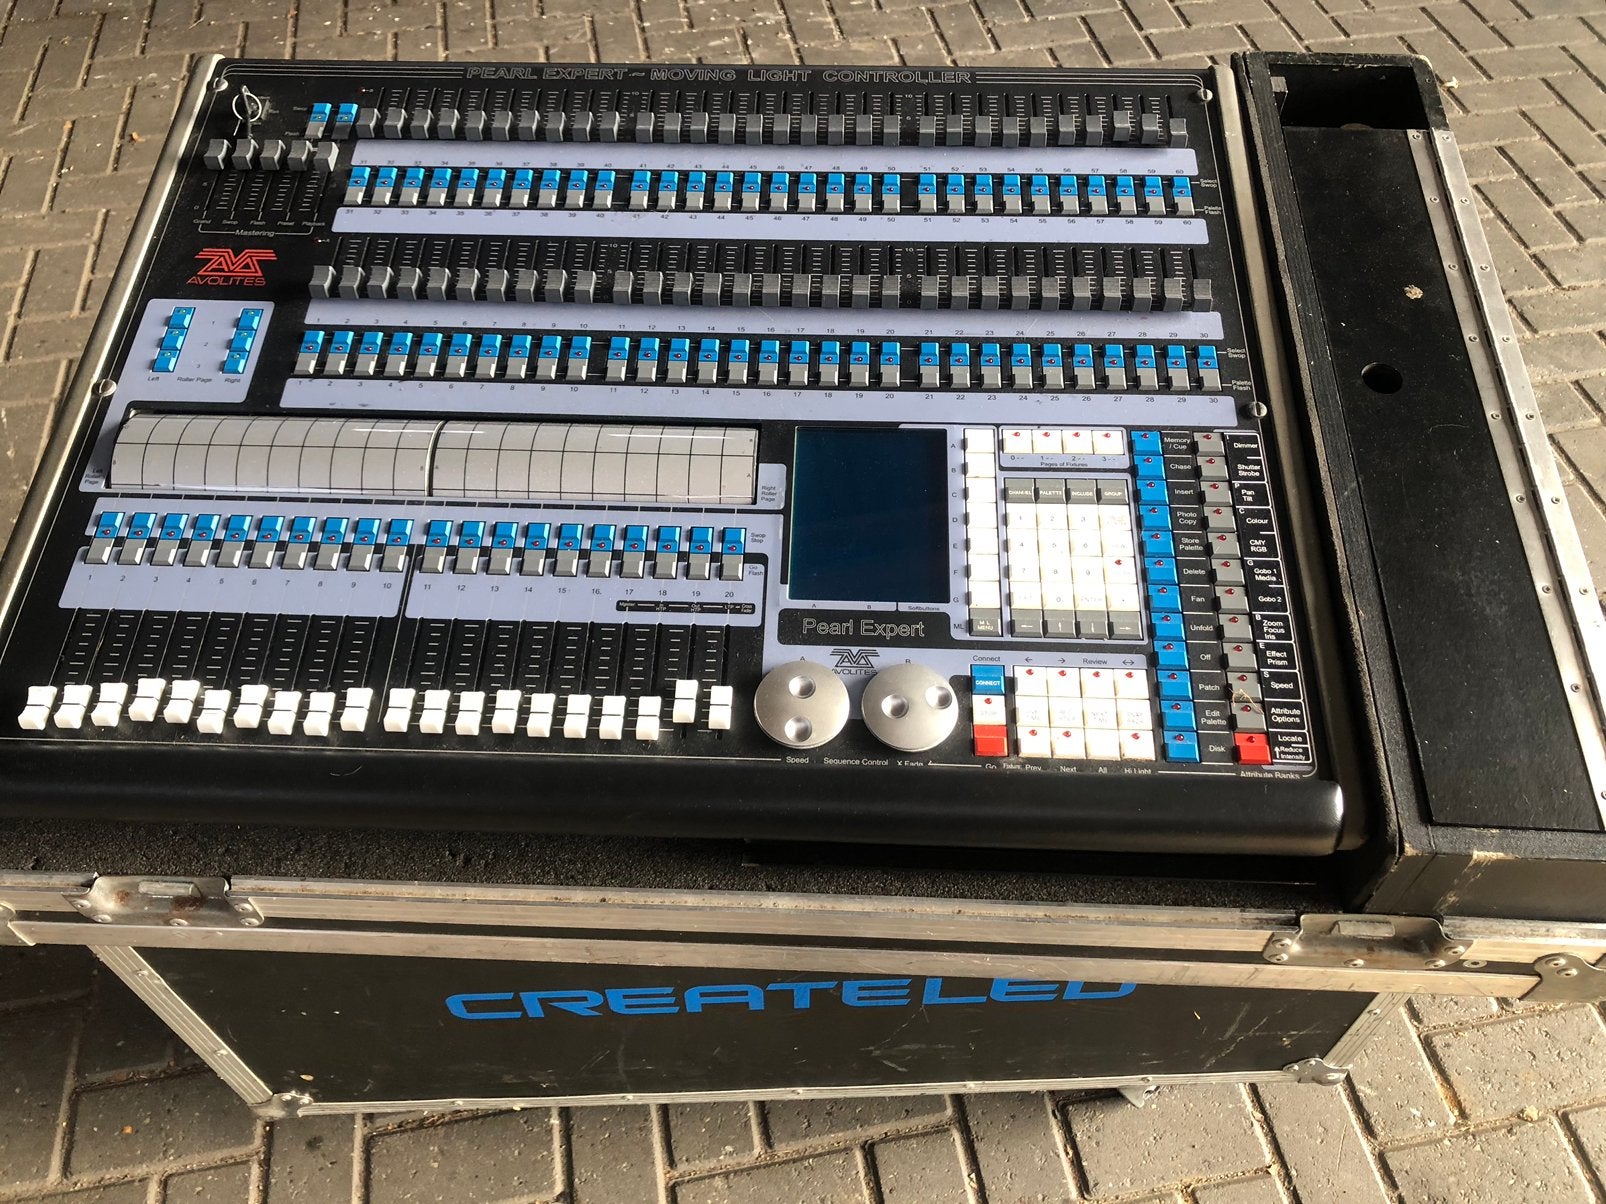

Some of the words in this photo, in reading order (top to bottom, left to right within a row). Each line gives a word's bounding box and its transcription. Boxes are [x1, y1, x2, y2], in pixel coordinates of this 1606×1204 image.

[467, 68, 537, 80] PEARL
[543, 68, 628, 80] EXPERT
[650, 68, 736, 81] MOVING
[748, 70, 811, 82] LIGHT
[822, 70, 971, 84] CONTROLLER
[186, 276, 266, 286] AVOLITES
[802, 618, 853, 636] Pearl
[860, 620, 924, 640] Expert
[445, 977, 1137, 1020] CREATELED
